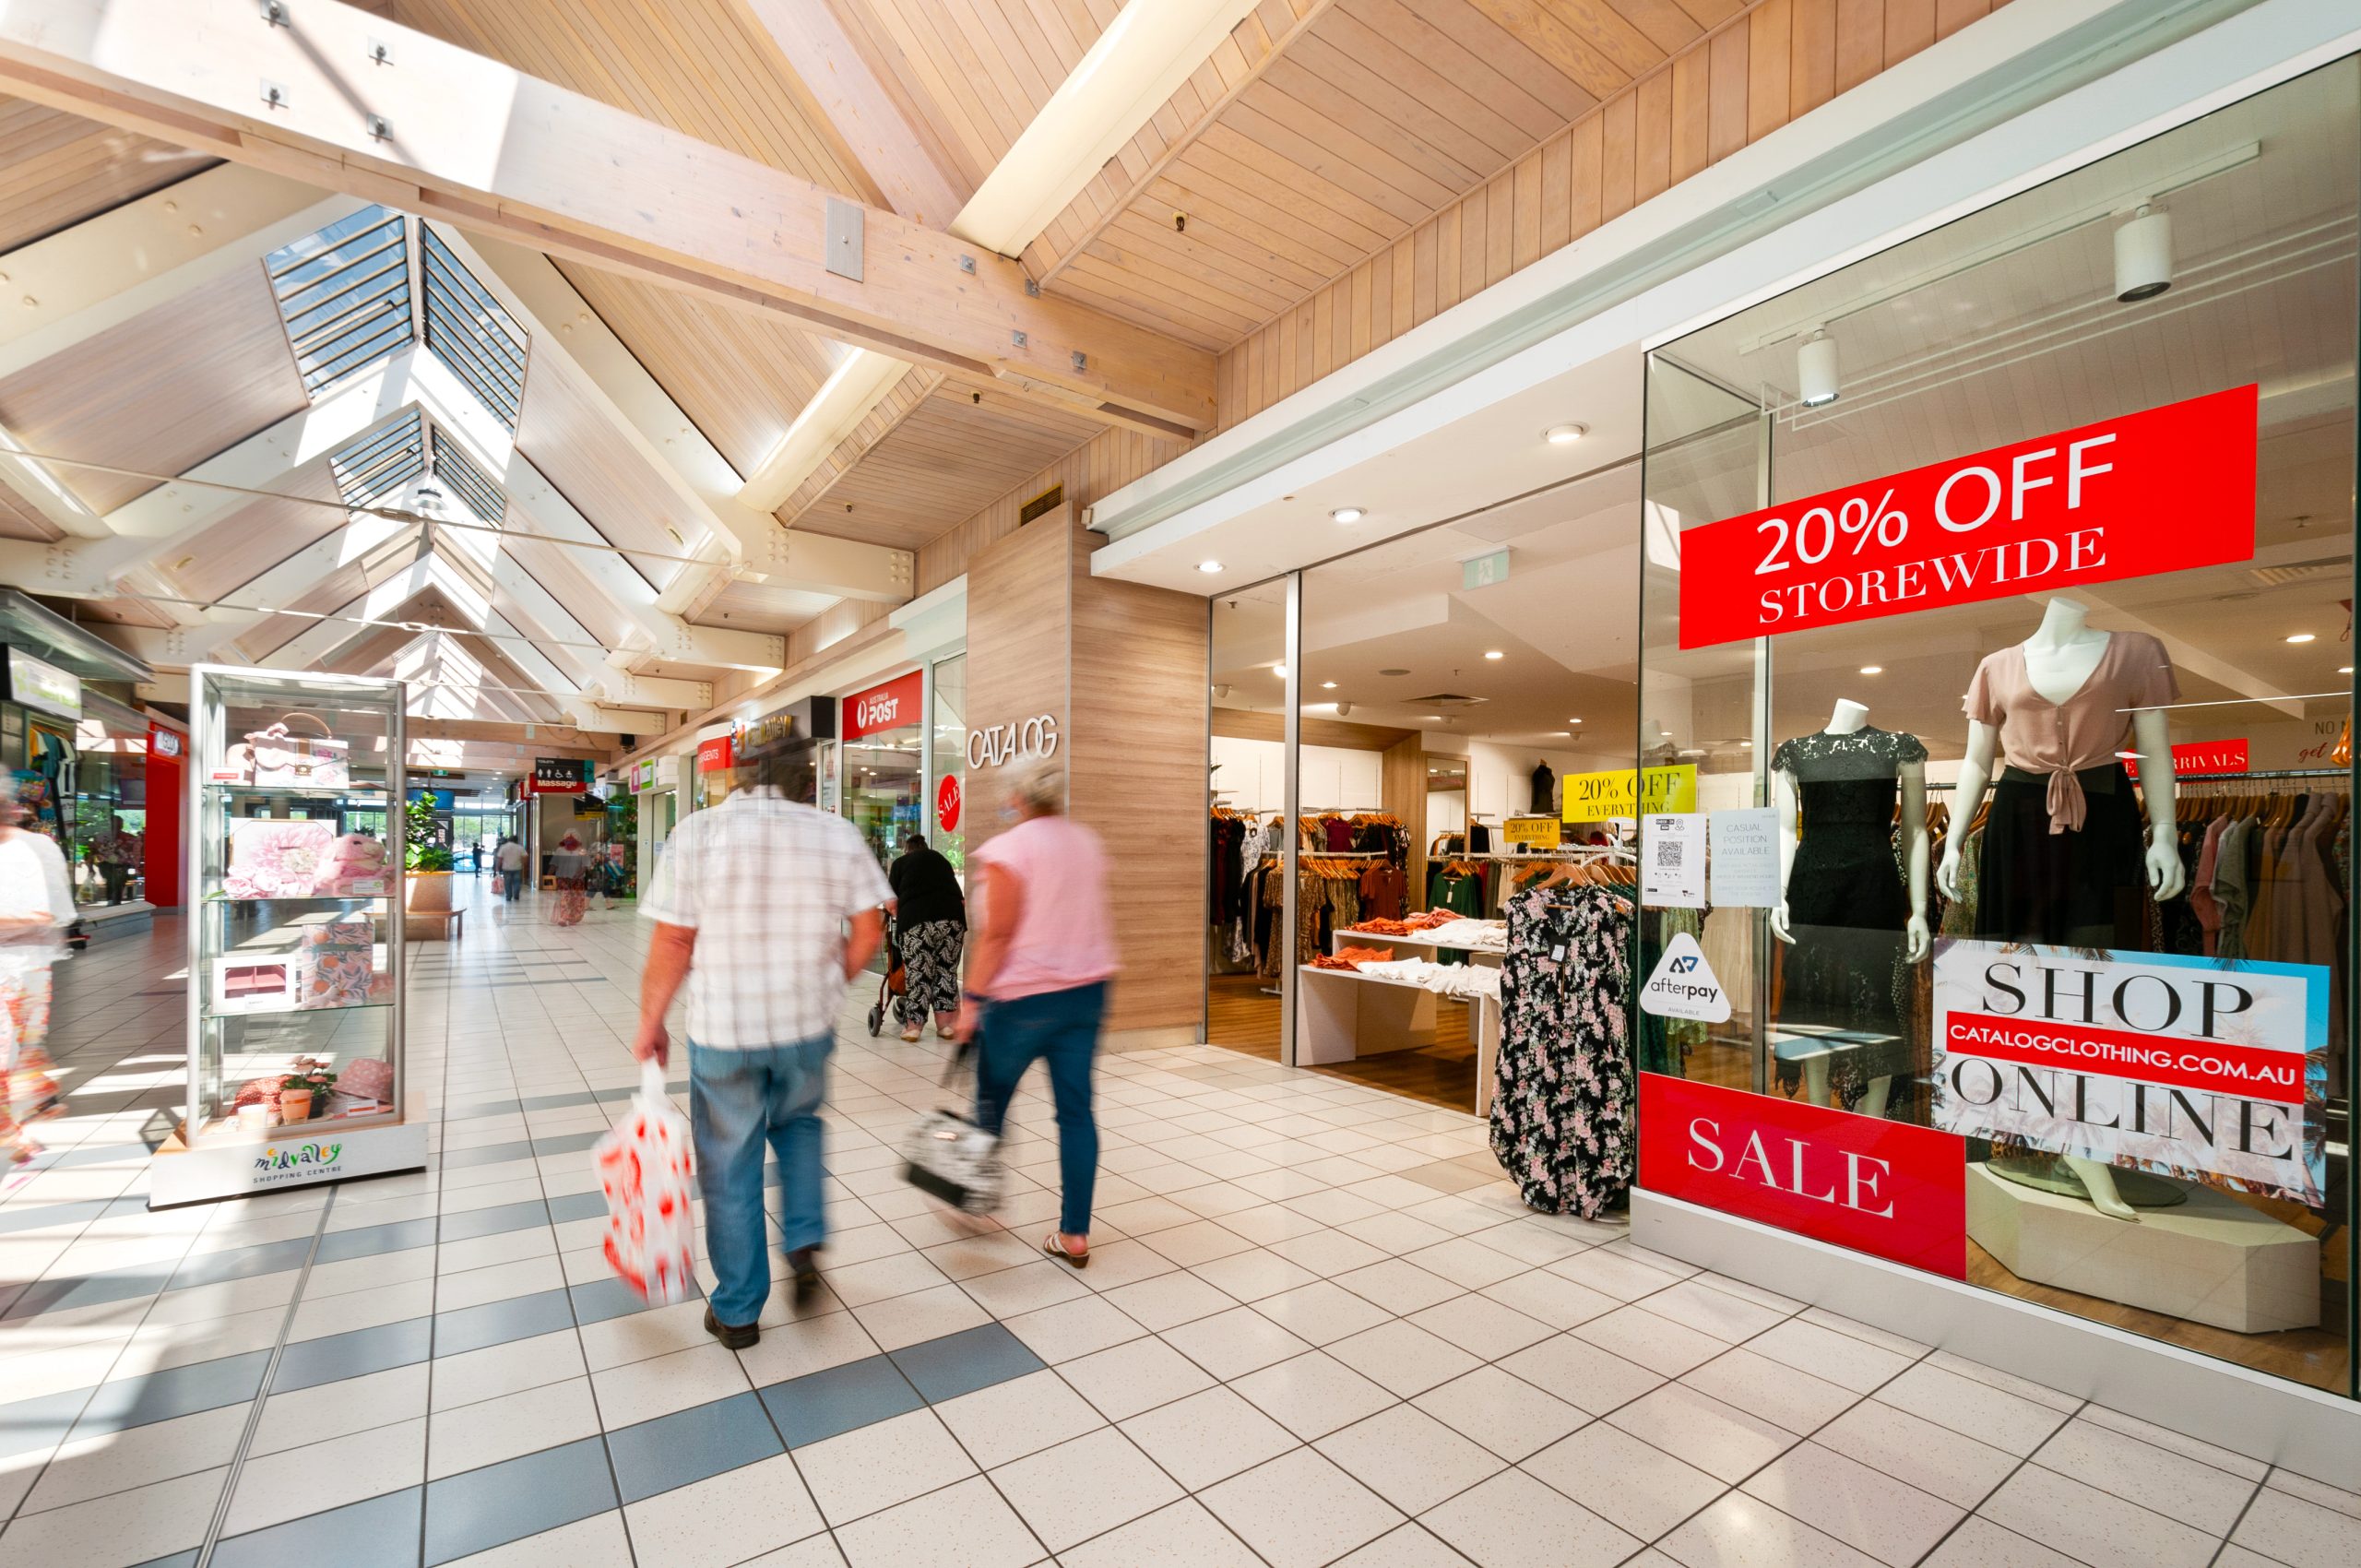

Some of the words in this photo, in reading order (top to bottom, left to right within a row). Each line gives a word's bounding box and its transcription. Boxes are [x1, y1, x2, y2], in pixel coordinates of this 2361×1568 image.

[1754, 488, 1909, 576] 20%
[1934, 432, 2118, 533] OFF
[1759, 526, 2106, 624] STOREWIDE
[869, 697, 899, 726] POST
[2315, 720, 2335, 735] NO
[967, 714, 1059, 769] CATALOG
[2297, 742, 2328, 764] get
[2173, 752, 2247, 770] RIVALS
[538, 779, 577, 789] Massage
[1579, 777, 1619, 801] 20%
[1627, 773, 1680, 798] OFF
[938, 784, 960, 821] SALE
[1510, 822, 1528, 833] 20%
[1531, 822, 1554, 833] OFF
[1723, 835, 1768, 844] POSITION
[1726, 823, 1762, 833] CASUAL
[1721, 846, 1771, 856] AVAILABLE
[1651, 978, 1718, 1004] afterpay
[1983, 962, 2253, 1039] SHOP
[1667, 1006, 1700, 1016] AVAILABLE
[1950, 1024, 2296, 1087] CATALOGCLOTHING.COM.AU
[1951, 1057, 2294, 1161] ONLINE
[254, 1143, 342, 1171] midvalley
[1688, 1117, 1893, 1218] SALE
[253, 1171, 303, 1184] SHOPPING
[306, 1165, 341, 1176] CENTRE
